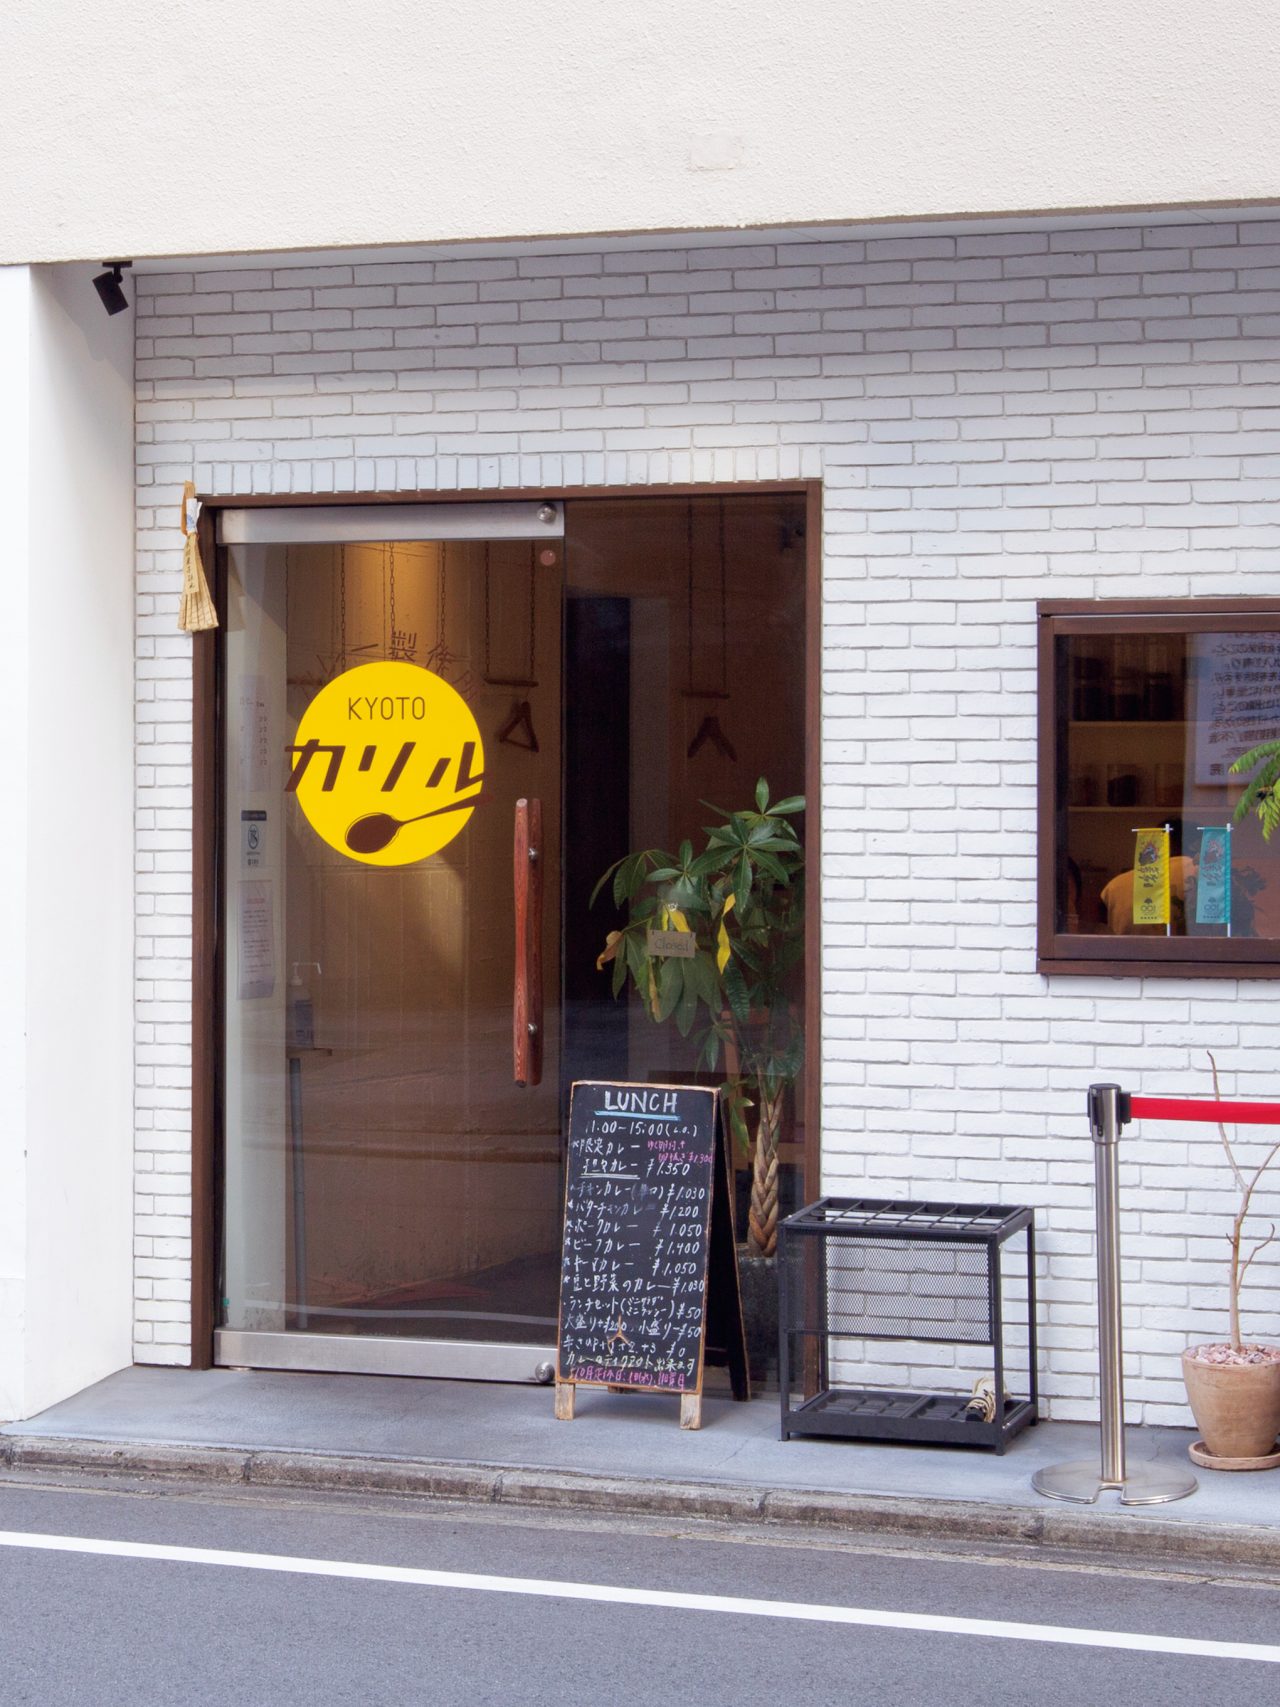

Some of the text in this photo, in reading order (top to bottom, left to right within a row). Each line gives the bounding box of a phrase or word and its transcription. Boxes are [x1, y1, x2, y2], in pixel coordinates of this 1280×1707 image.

[348, 696, 426, 721] KYOTO
[284, 739, 491, 794] カリル
[604, 1090, 678, 1113] LUNCH
[574, 1238, 641, 1254] ビーフカレー
[574, 1254, 634, 1272] キーマカレー
[573, 1273, 671, 1293] 豆と野菜のカレー
